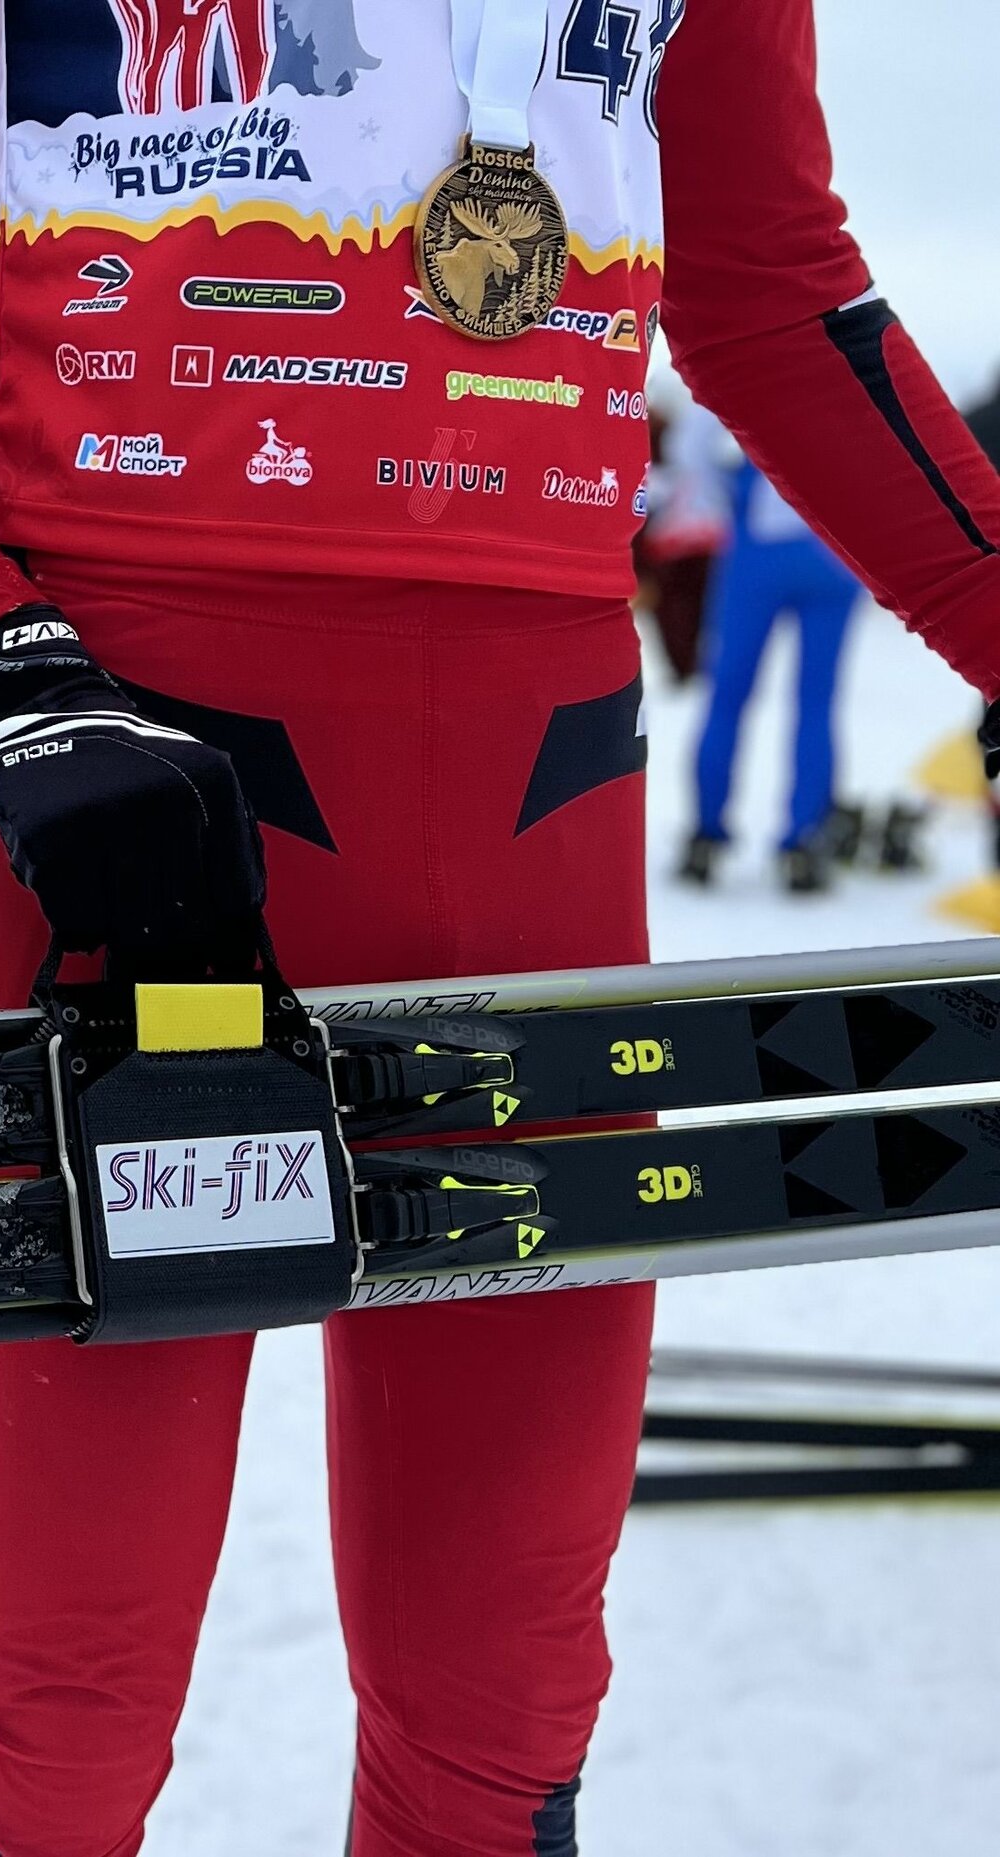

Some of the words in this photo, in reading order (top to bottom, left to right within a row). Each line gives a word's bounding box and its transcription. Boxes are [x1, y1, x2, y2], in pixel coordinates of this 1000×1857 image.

[75, 133, 120, 168] Big
[130, 129, 192, 158] race
[205, 117, 238, 152] of
[241, 107, 291, 147] big
[115, 146, 312, 199] RUSSIA
[471, 146, 534, 171] Rostec
[468, 167, 533, 190] Demino
[423, 228, 450, 300] ДЕМИНО
[194, 285, 333, 304] POWERUP
[456, 309, 522, 335] ФИНИШЕР
[543, 310, 608, 338] стер
[86, 353, 135, 378] RM
[226, 357, 406, 388] MADSHUS
[447, 371, 578, 406] greenworks
[608, 391, 648, 417] MO
[123, 437, 160, 454] МОЙ
[119, 457, 183, 473] СПОРТ
[248, 462, 311, 478] bionova
[377, 459, 505, 493] BIVIUM
[2, 739, 73, 767] FOCUS
[610, 1039, 664, 1075] 3D
[662, 1038, 676, 1071] GLIDE
[106, 1140, 316, 1220] Ski-fiX
[637, 1165, 692, 1203] 3D
[690, 1164, 704, 1198] GLIDE
